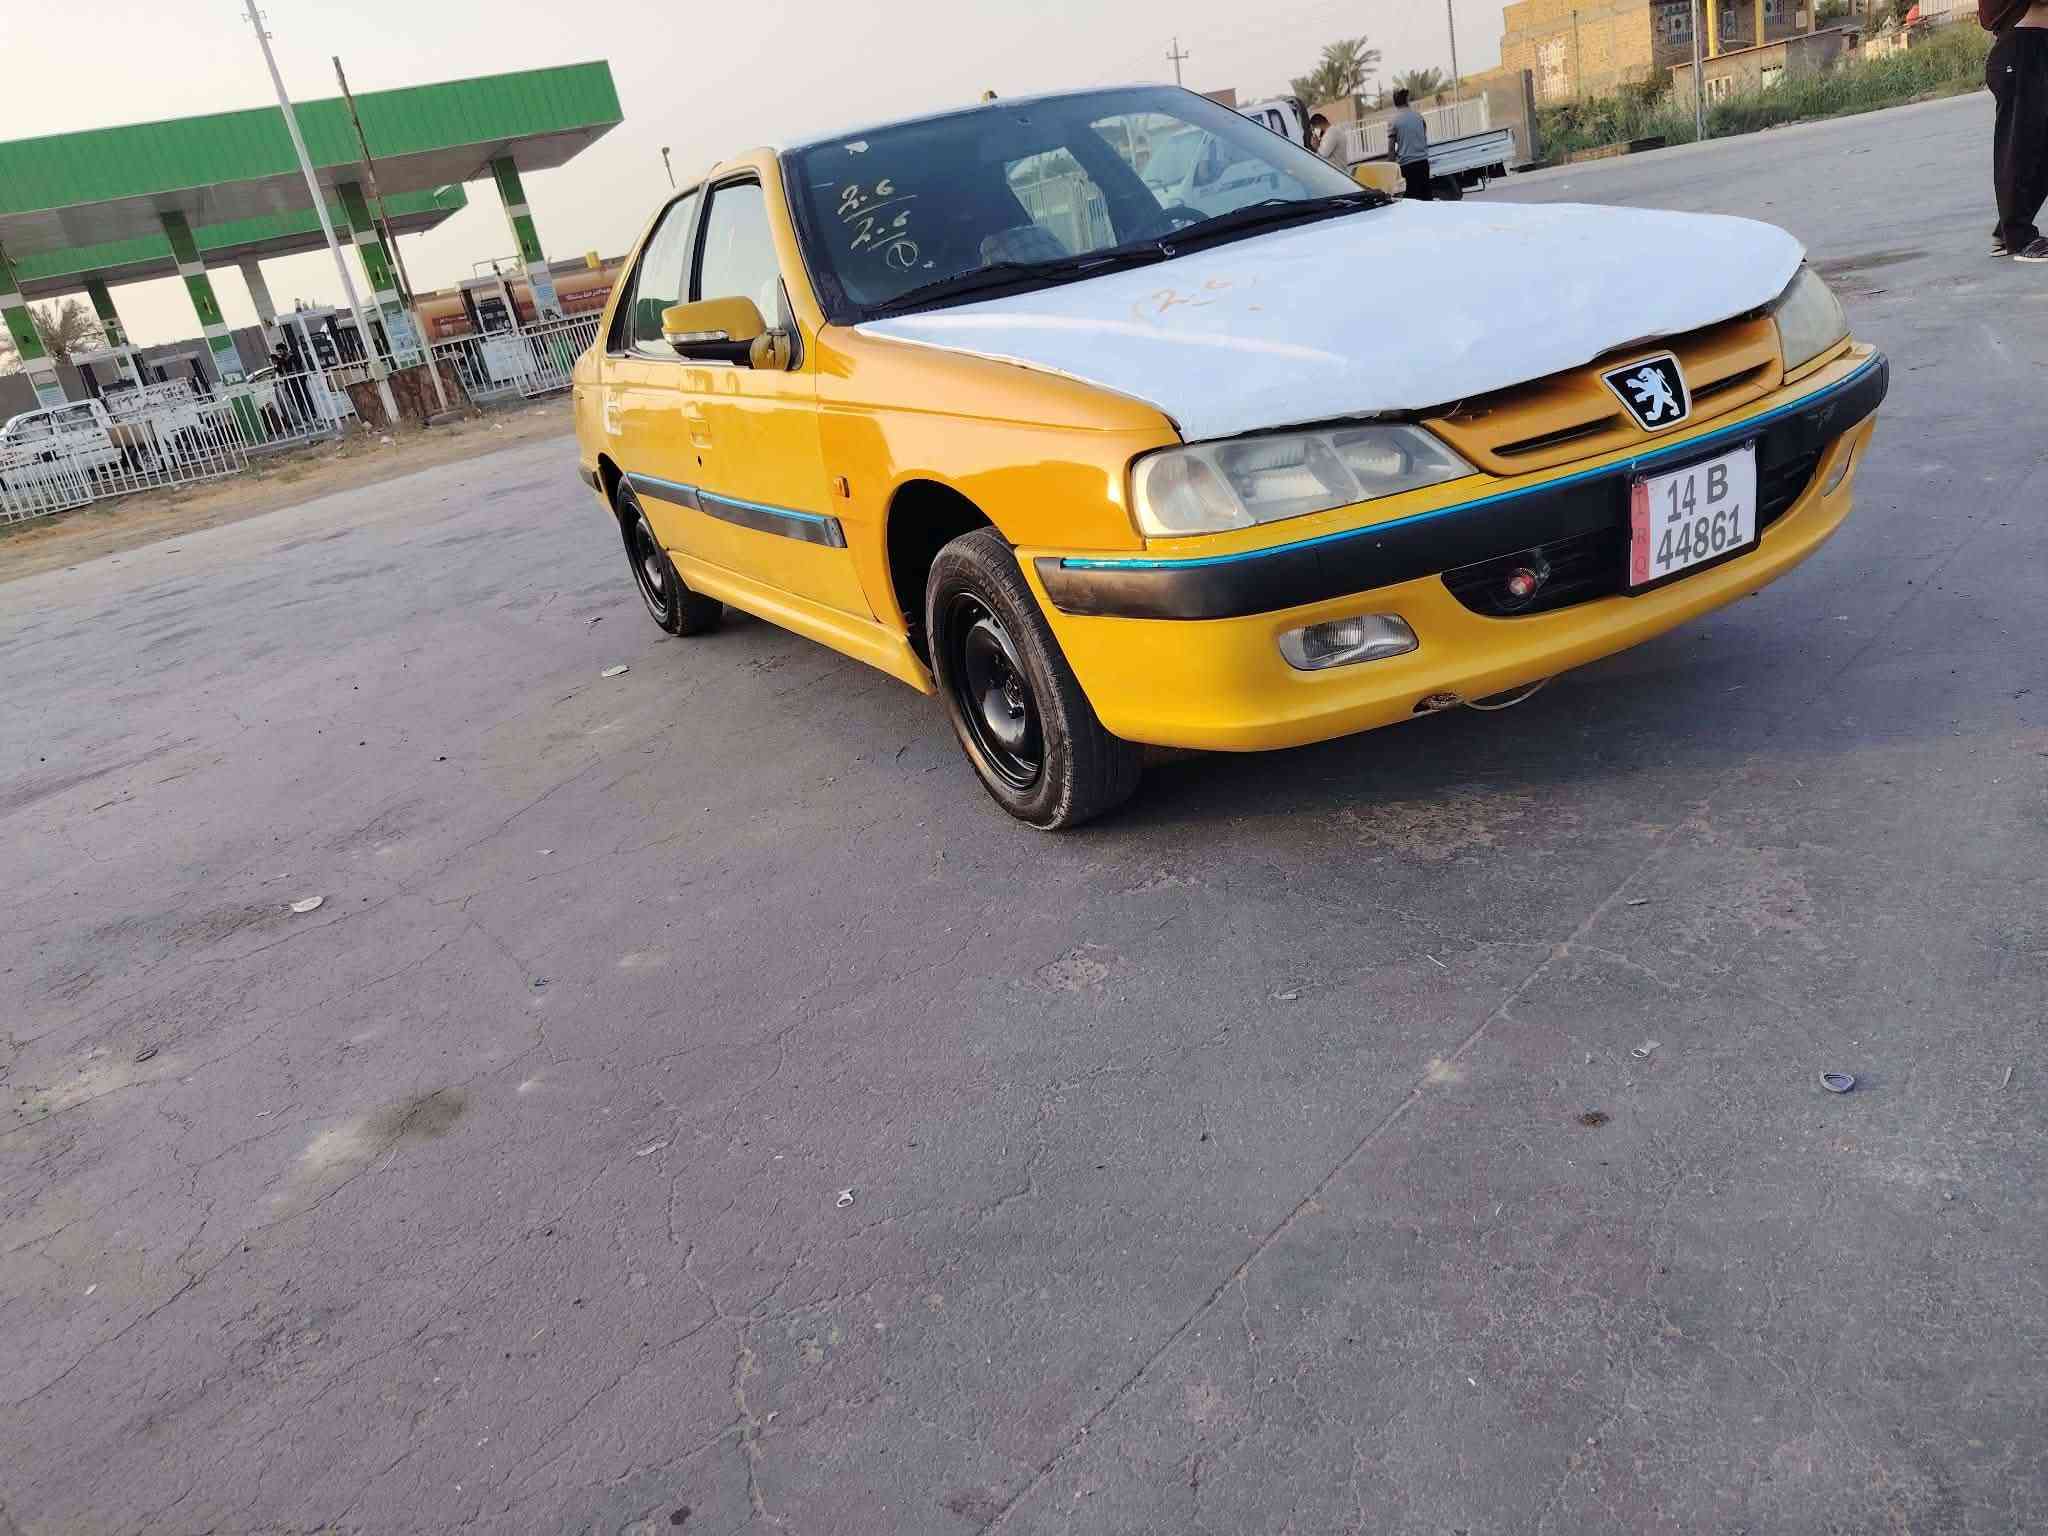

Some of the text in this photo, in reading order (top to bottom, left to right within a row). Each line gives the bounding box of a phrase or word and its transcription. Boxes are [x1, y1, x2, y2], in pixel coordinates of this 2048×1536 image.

[1668, 464, 1729, 522] 14 B
[1656, 504, 1742, 570] 44861
